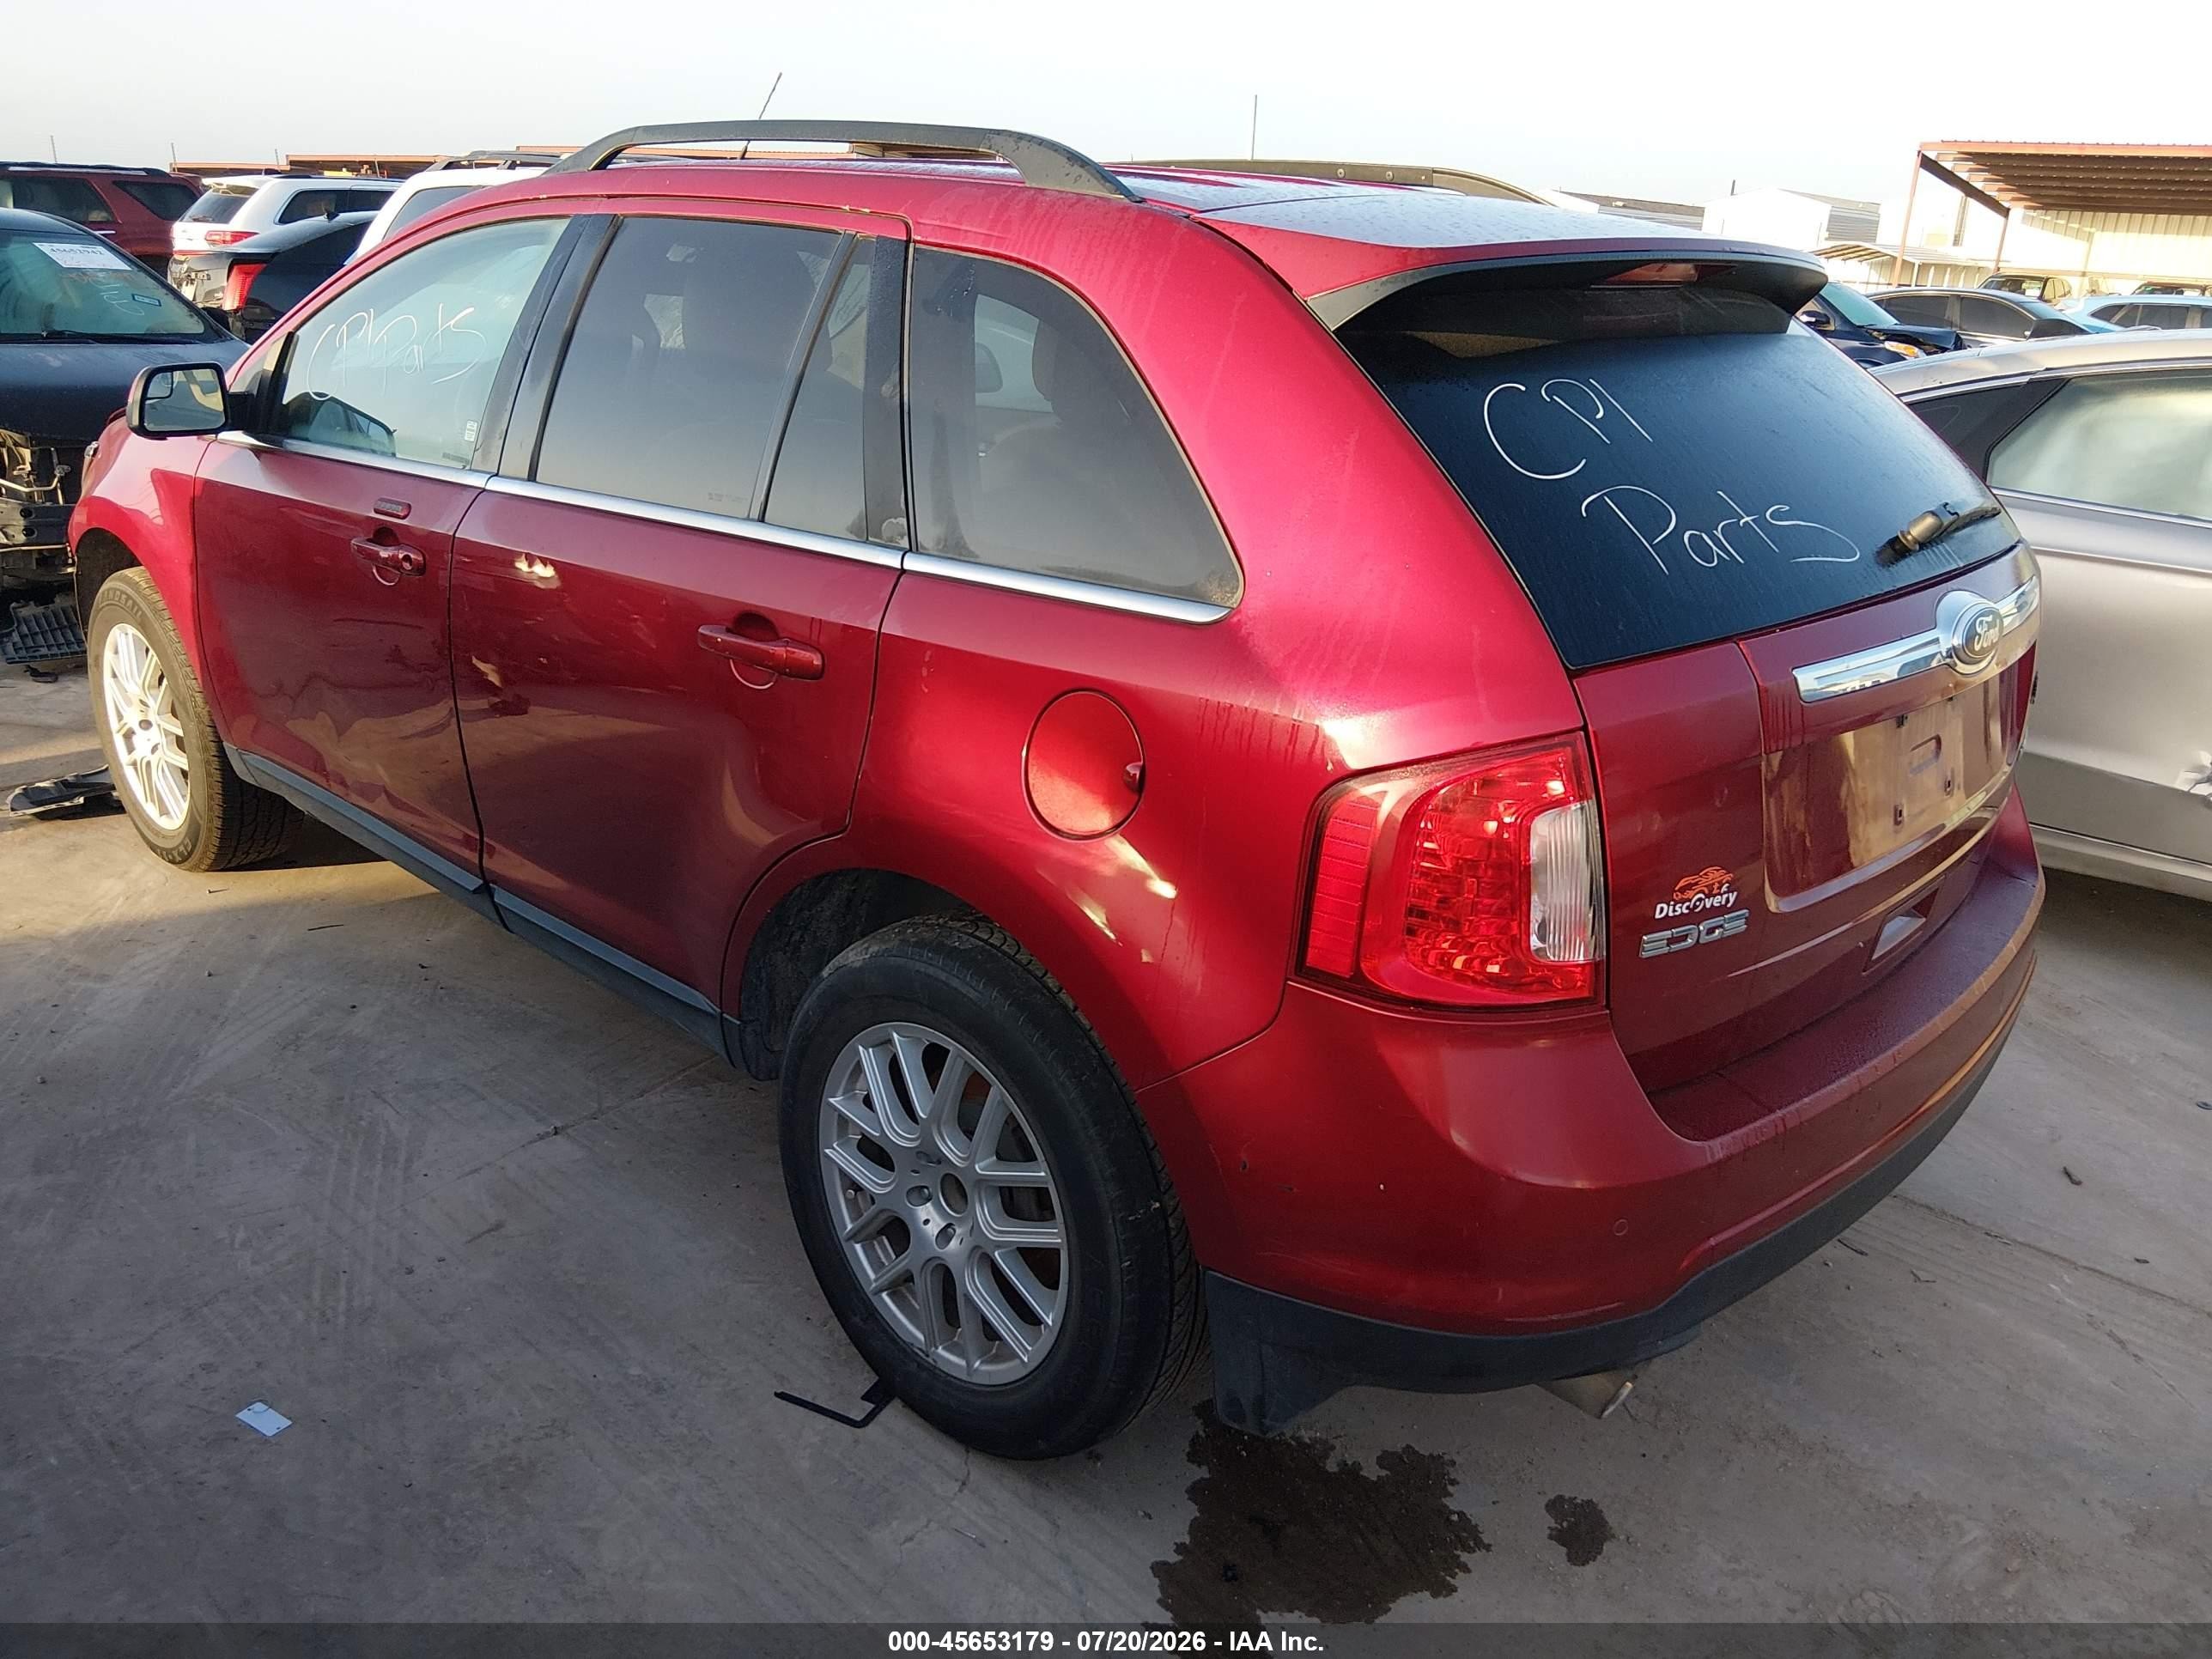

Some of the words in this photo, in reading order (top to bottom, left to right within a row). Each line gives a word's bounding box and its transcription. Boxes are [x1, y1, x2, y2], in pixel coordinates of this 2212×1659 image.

[373, 302, 488, 397] Parts
[1483, 377, 1653, 480] CPI
[1580, 484, 1861, 575] Parts
[1974, 613, 2001, 652] Ford
[1638, 908, 1750, 959] EDGE
